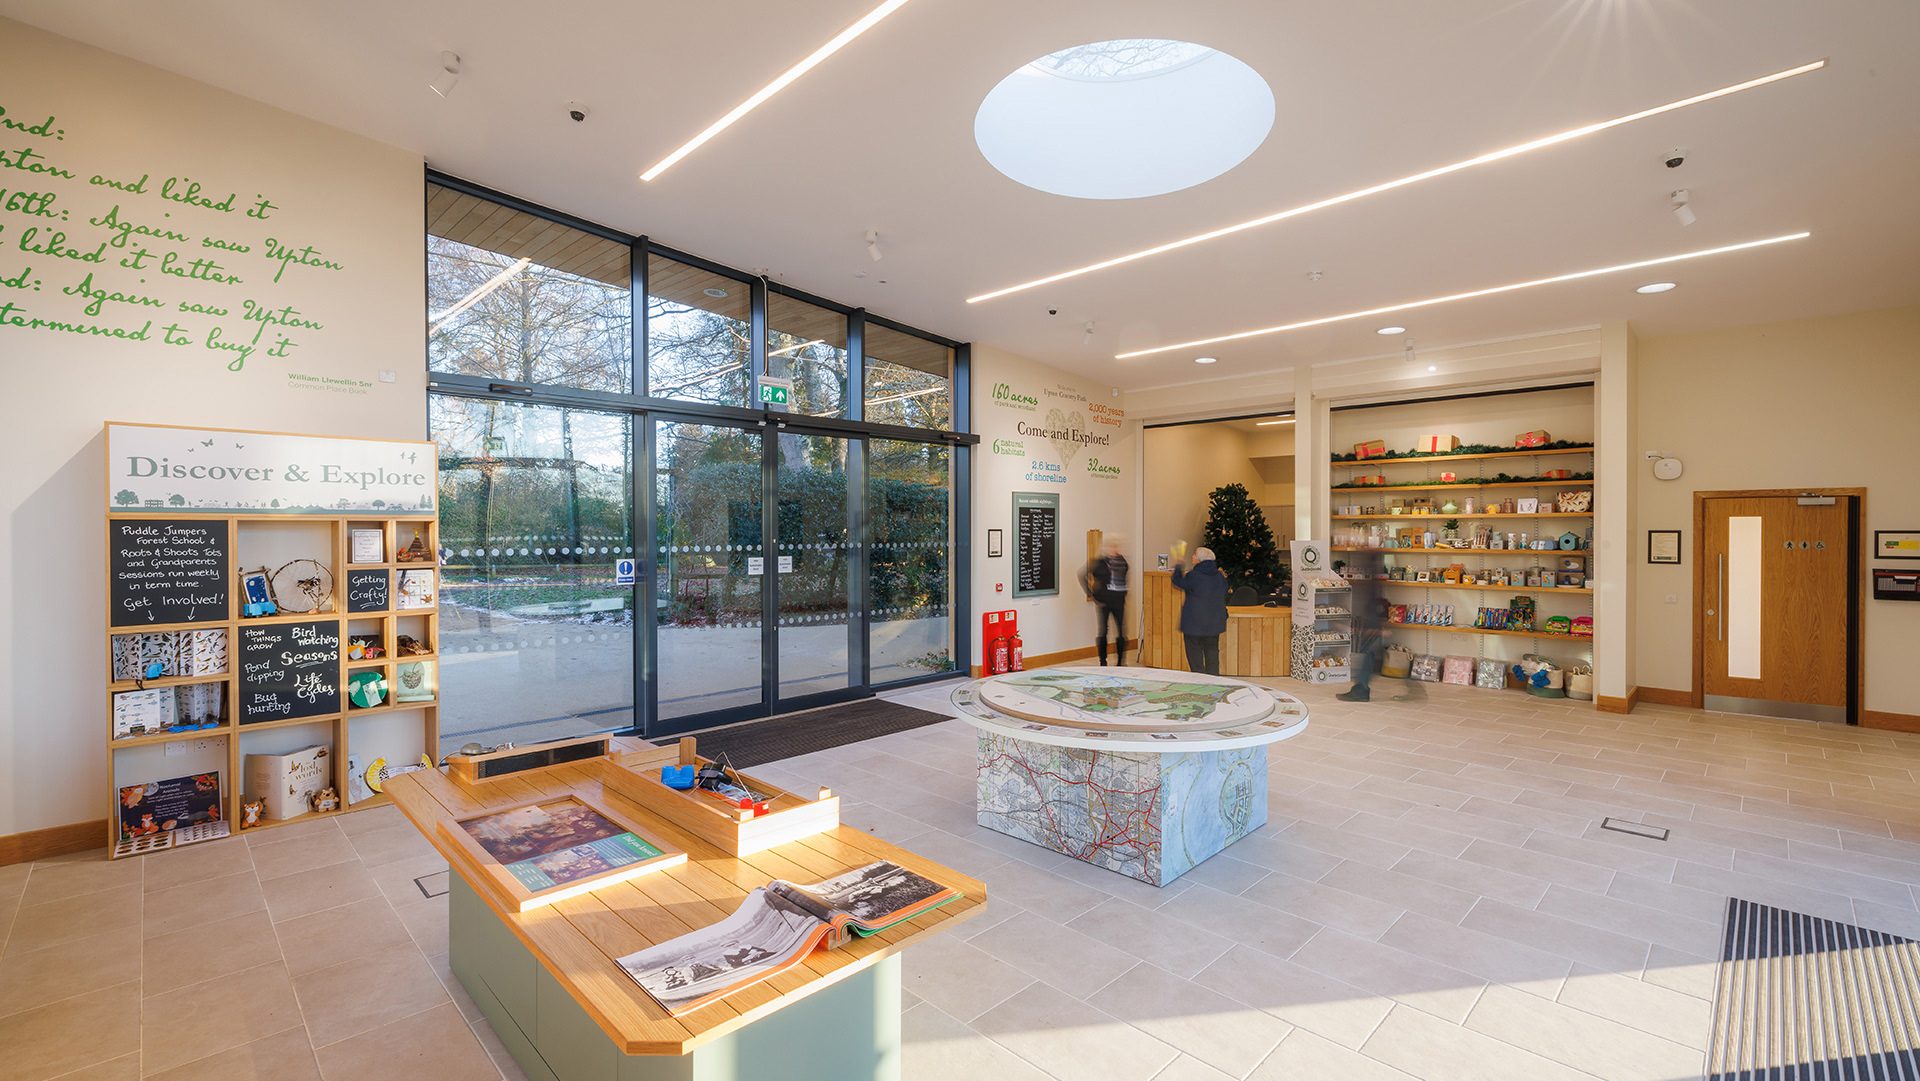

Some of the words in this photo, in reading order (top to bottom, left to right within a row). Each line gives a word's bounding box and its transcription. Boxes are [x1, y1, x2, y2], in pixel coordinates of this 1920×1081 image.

[90, 174, 148, 194] and
[161, 177, 236, 212] liked
[246, 194, 279, 219] it
[90, 205, 190, 248] Again
[202, 237, 250, 253] saw
[265, 238, 344, 283] Upton
[19, 227, 107, 263] liked
[120, 242, 158, 269] it
[161, 252, 243, 284] better
[63, 272, 166, 316] Again
[179, 301, 228, 316] saw
[243, 300, 323, 344] Upton
[162, 323, 192, 345] to
[206, 327, 256, 371] buy
[267, 333, 298, 357] it
[288, 373, 319, 382] William
[322, 377, 356, 386] Llewellin
[288, 380, 325, 390] Common
[992, 384, 1010, 400] 160
[1011, 394, 1038, 406] acres
[1088, 403, 1107, 414] 2,000
[1107, 407, 1125, 418] years
[1099, 416, 1122, 428] history
[1018, 422, 1048, 438] Come
[1051, 428, 1068, 441] and
[1072, 430, 1110, 448] Explore!
[992, 438, 1000, 454] 6
[1001, 440, 1024, 448] natural
[1001, 448, 1025, 456] habitats
[127, 456, 274, 481] Discover
[284, 464, 310, 482] &
[320, 464, 426, 490] Explore
[1032, 461, 1044, 471] 2.6
[1046, 461, 1060, 472] kms
[1088, 458, 1098, 471] 32
[1099, 466, 1120, 474] acres
[1026, 473, 1032, 481] of
[1034, 473, 1067, 484] shoreline
[122, 526, 159, 536] Puddle
[164, 525, 207, 537] Jumpers
[136, 536, 168, 544] Forest
[172, 536, 205, 544] School
[120, 549, 152, 558] Roots
[163, 548, 198, 556] Shoots
[203, 548, 222, 556] Tots
[150, 558, 216, 569] Grandparents
[188, 569, 220, 580] weekly
[145, 581, 170, 589] term
[352, 576, 386, 590] Getting
[124, 597, 152, 611] Get
[162, 593, 224, 606] Involved!
[350, 588, 388, 606] Crafty!
[292, 625, 316, 639] Bird
[247, 643, 273, 651] GROW
[298, 634, 338, 648] watching
[281, 650, 338, 666] Seasons
[245, 660, 270, 673] Pond
[247, 670, 284, 684] dipping
[294, 672, 322, 691] Life
[254, 693, 277, 704] Bug
[297, 684, 336, 704] Cycles
[248, 702, 290, 714] hunting
